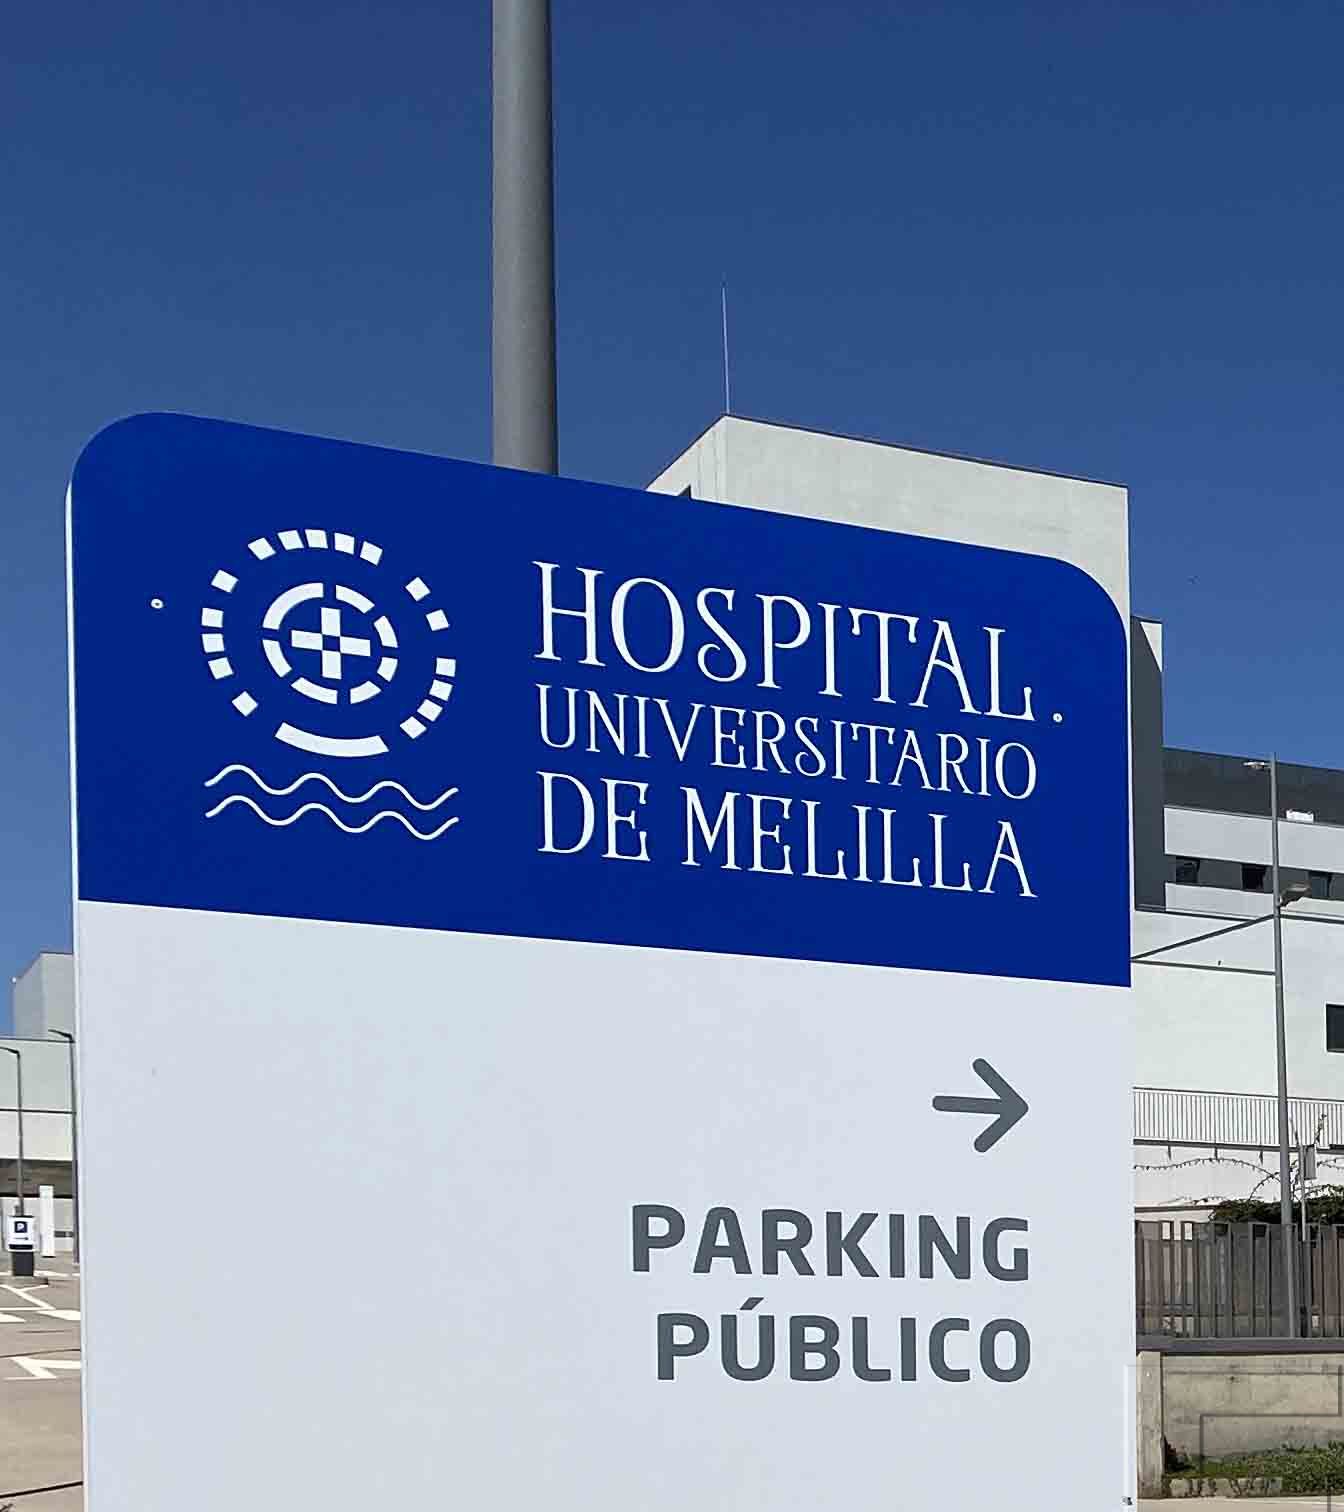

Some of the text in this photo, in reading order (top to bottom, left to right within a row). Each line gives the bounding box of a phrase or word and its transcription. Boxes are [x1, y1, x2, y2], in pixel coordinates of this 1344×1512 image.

[531, 559, 1038, 722] HOSPITAL
[534, 683, 1038, 800] UNIVERSITARIO
[537, 770, 1039, 899] DE MELILLA
[631, 1204, 1029, 1282] PARKING
[656, 1296, 1031, 1383] PÚBLICO
